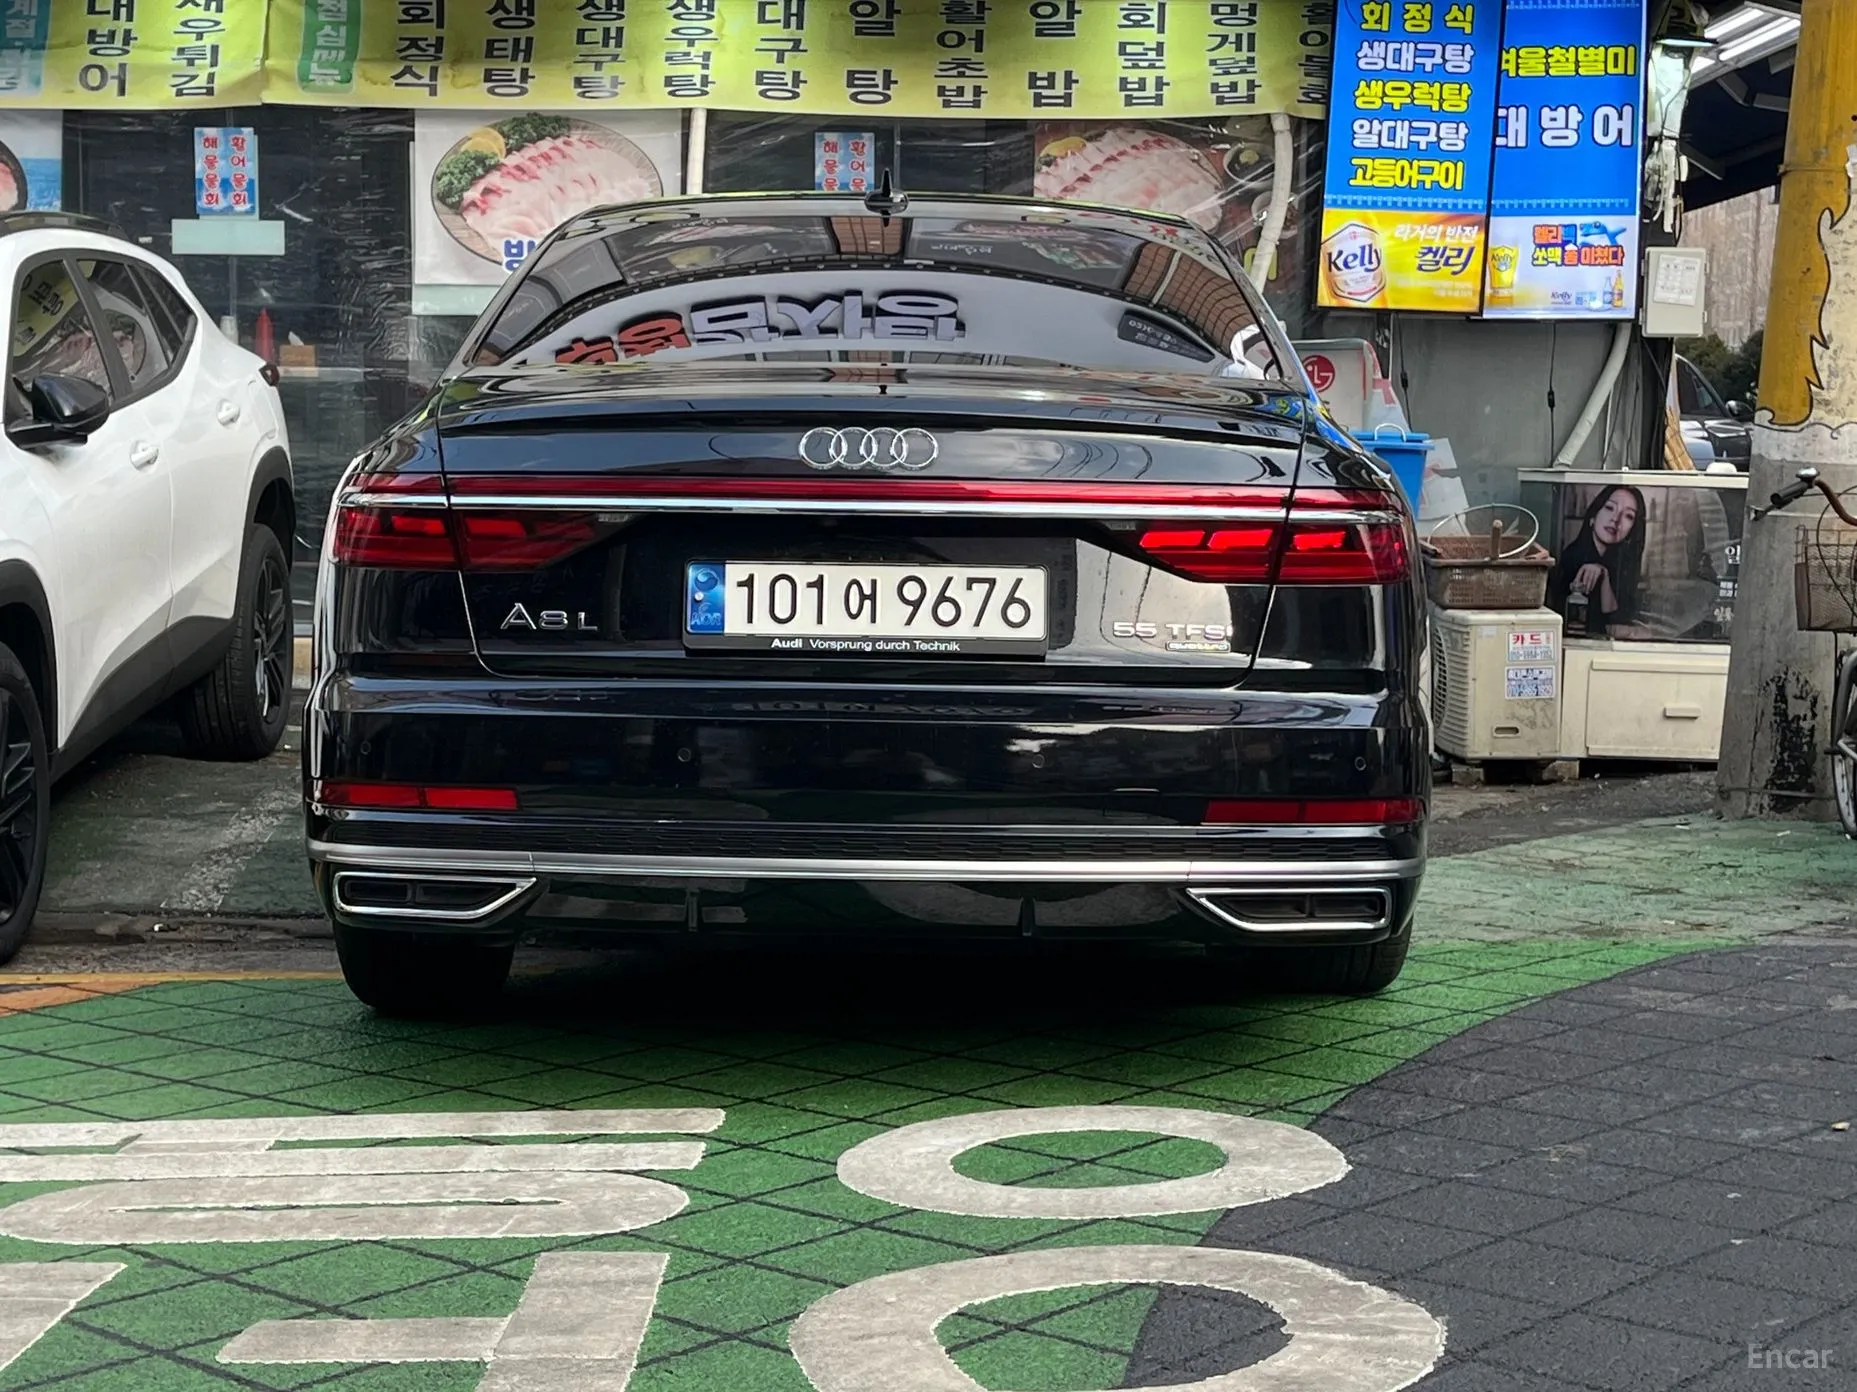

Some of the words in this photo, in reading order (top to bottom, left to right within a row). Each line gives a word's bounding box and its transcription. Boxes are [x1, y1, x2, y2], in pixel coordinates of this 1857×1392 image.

[79, 0, 138, 97] 대방어
[390, 0, 445, 97] 회정식
[483, 0, 535, 97] 생태탕
[573, 0, 626, 99] 생대구탕
[664, 0, 718, 98] 생우럭탕
[755, 0, 808, 101] 대구탕
[846, 0, 901, 105] 알탕
[934, 0, 992, 108] 활어초밥
[1028, 0, 1082, 107] 알밥
[1117, 2, 1171, 107] 회덮밥
[1206, 2, 1262, 106] 멍게덮밥
[1354, 80, 1472, 112] 생우럭탕
[1356, 41, 1475, 73] 생대구탕
[1349, 158, 1464, 190] 고등어구이
[1352, 119, 1469, 151] 알대구탕
[1327, 243, 1382, 273] Kelly
[1395, 224, 1442, 242] 라거의
[1446, 225, 1479, 244] 반전
[1415, 246, 1475, 276] 켈리
[736, 573, 878, 625] 101어
[896, 574, 1032, 629] 9676
[771, 638, 803, 649] Audi
[809, 639, 872, 652] Vorsprung
[875, 639, 910, 651] durch
[913, 640, 961, 652] Technik
[1113, 621, 1158, 639] 55
[1165, 623, 1234, 641] TFSI
